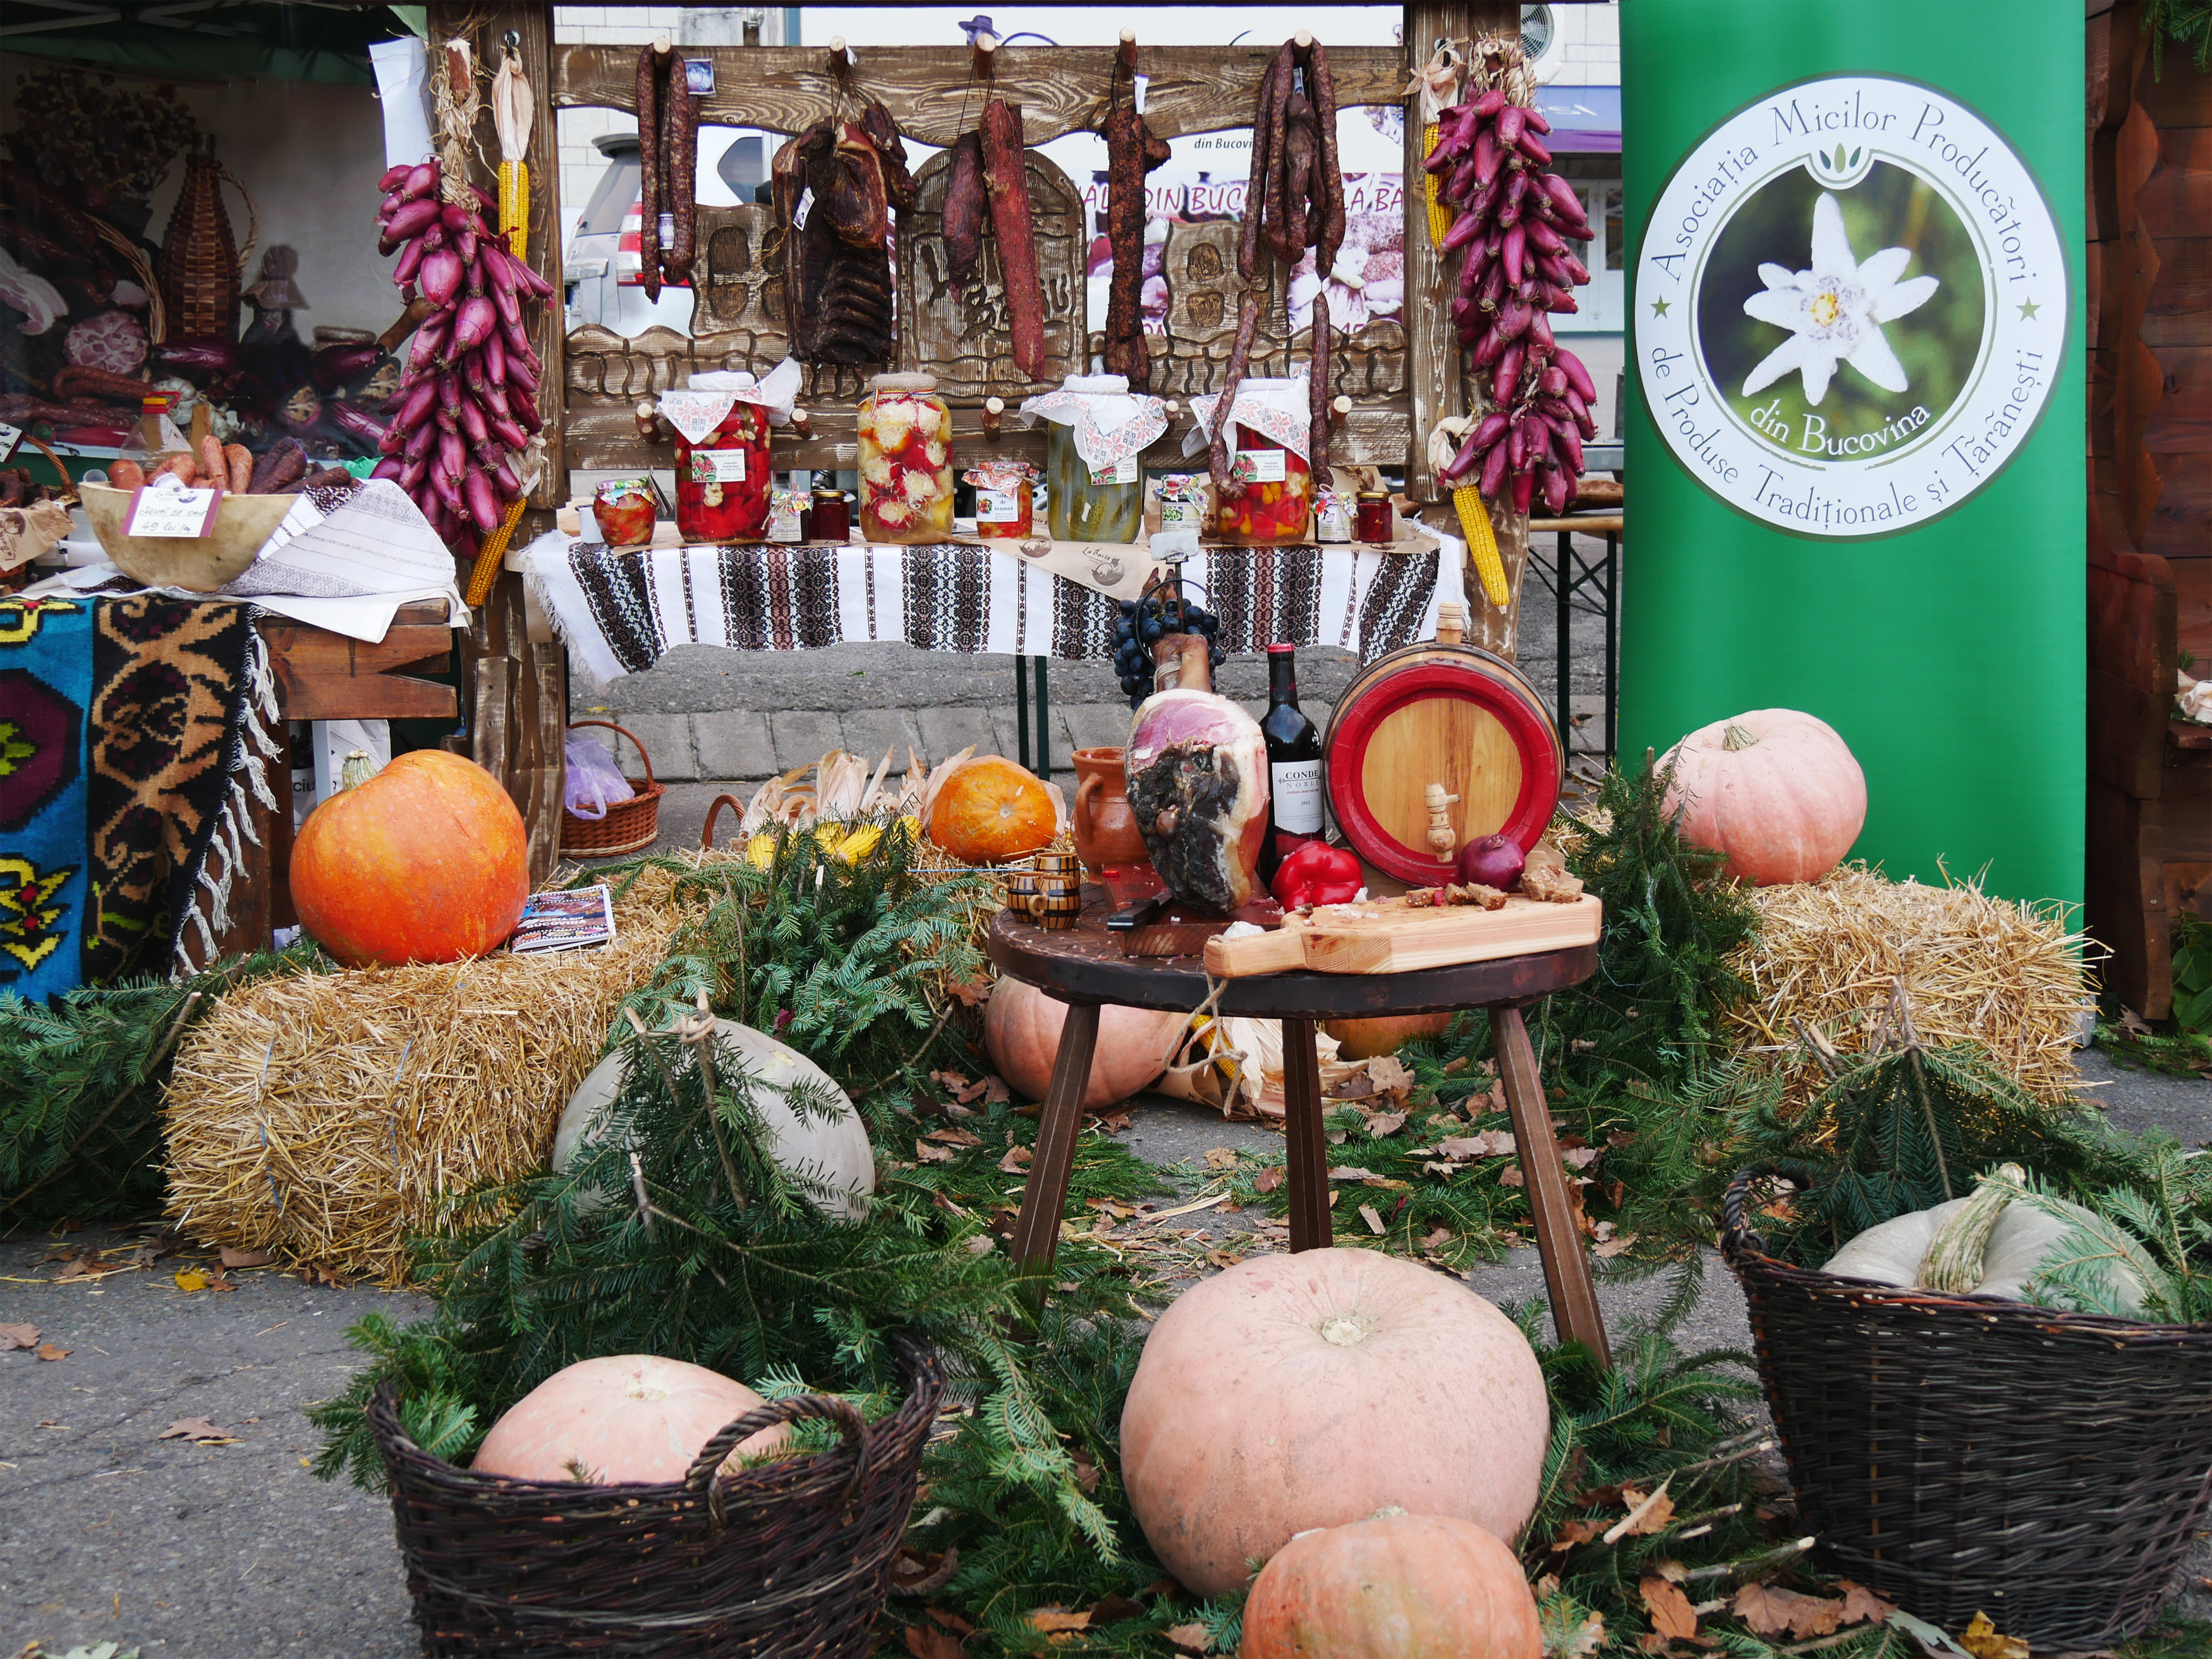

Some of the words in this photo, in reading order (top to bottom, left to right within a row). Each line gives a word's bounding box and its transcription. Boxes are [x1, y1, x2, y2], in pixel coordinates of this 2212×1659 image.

[1194, 138, 1212, 149] din
[1215, 138, 1253, 149] Bucovi
[1191, 186, 1248, 211] BUC
[1375, 187, 1403, 212] BA
[1650, 147, 1758, 285] Asociația
[1769, 90, 1896, 147] Micilor
[1652, 348, 1684, 379] de
[1663, 379, 1738, 483] Produse
[1750, 399, 1790, 443] din
[1797, 405, 1931, 456] Bucovina
[1751, 464, 1917, 530] Tradiționale
[1927, 470, 1950, 504] și
[142, 521, 159, 532] 49
[1083, 547, 1092, 555] La
[1093, 548, 1110, 561] Baciu
[1285, 770, 1318, 779] CONDE
[526, 919, 586, 929] BUCOVINA
